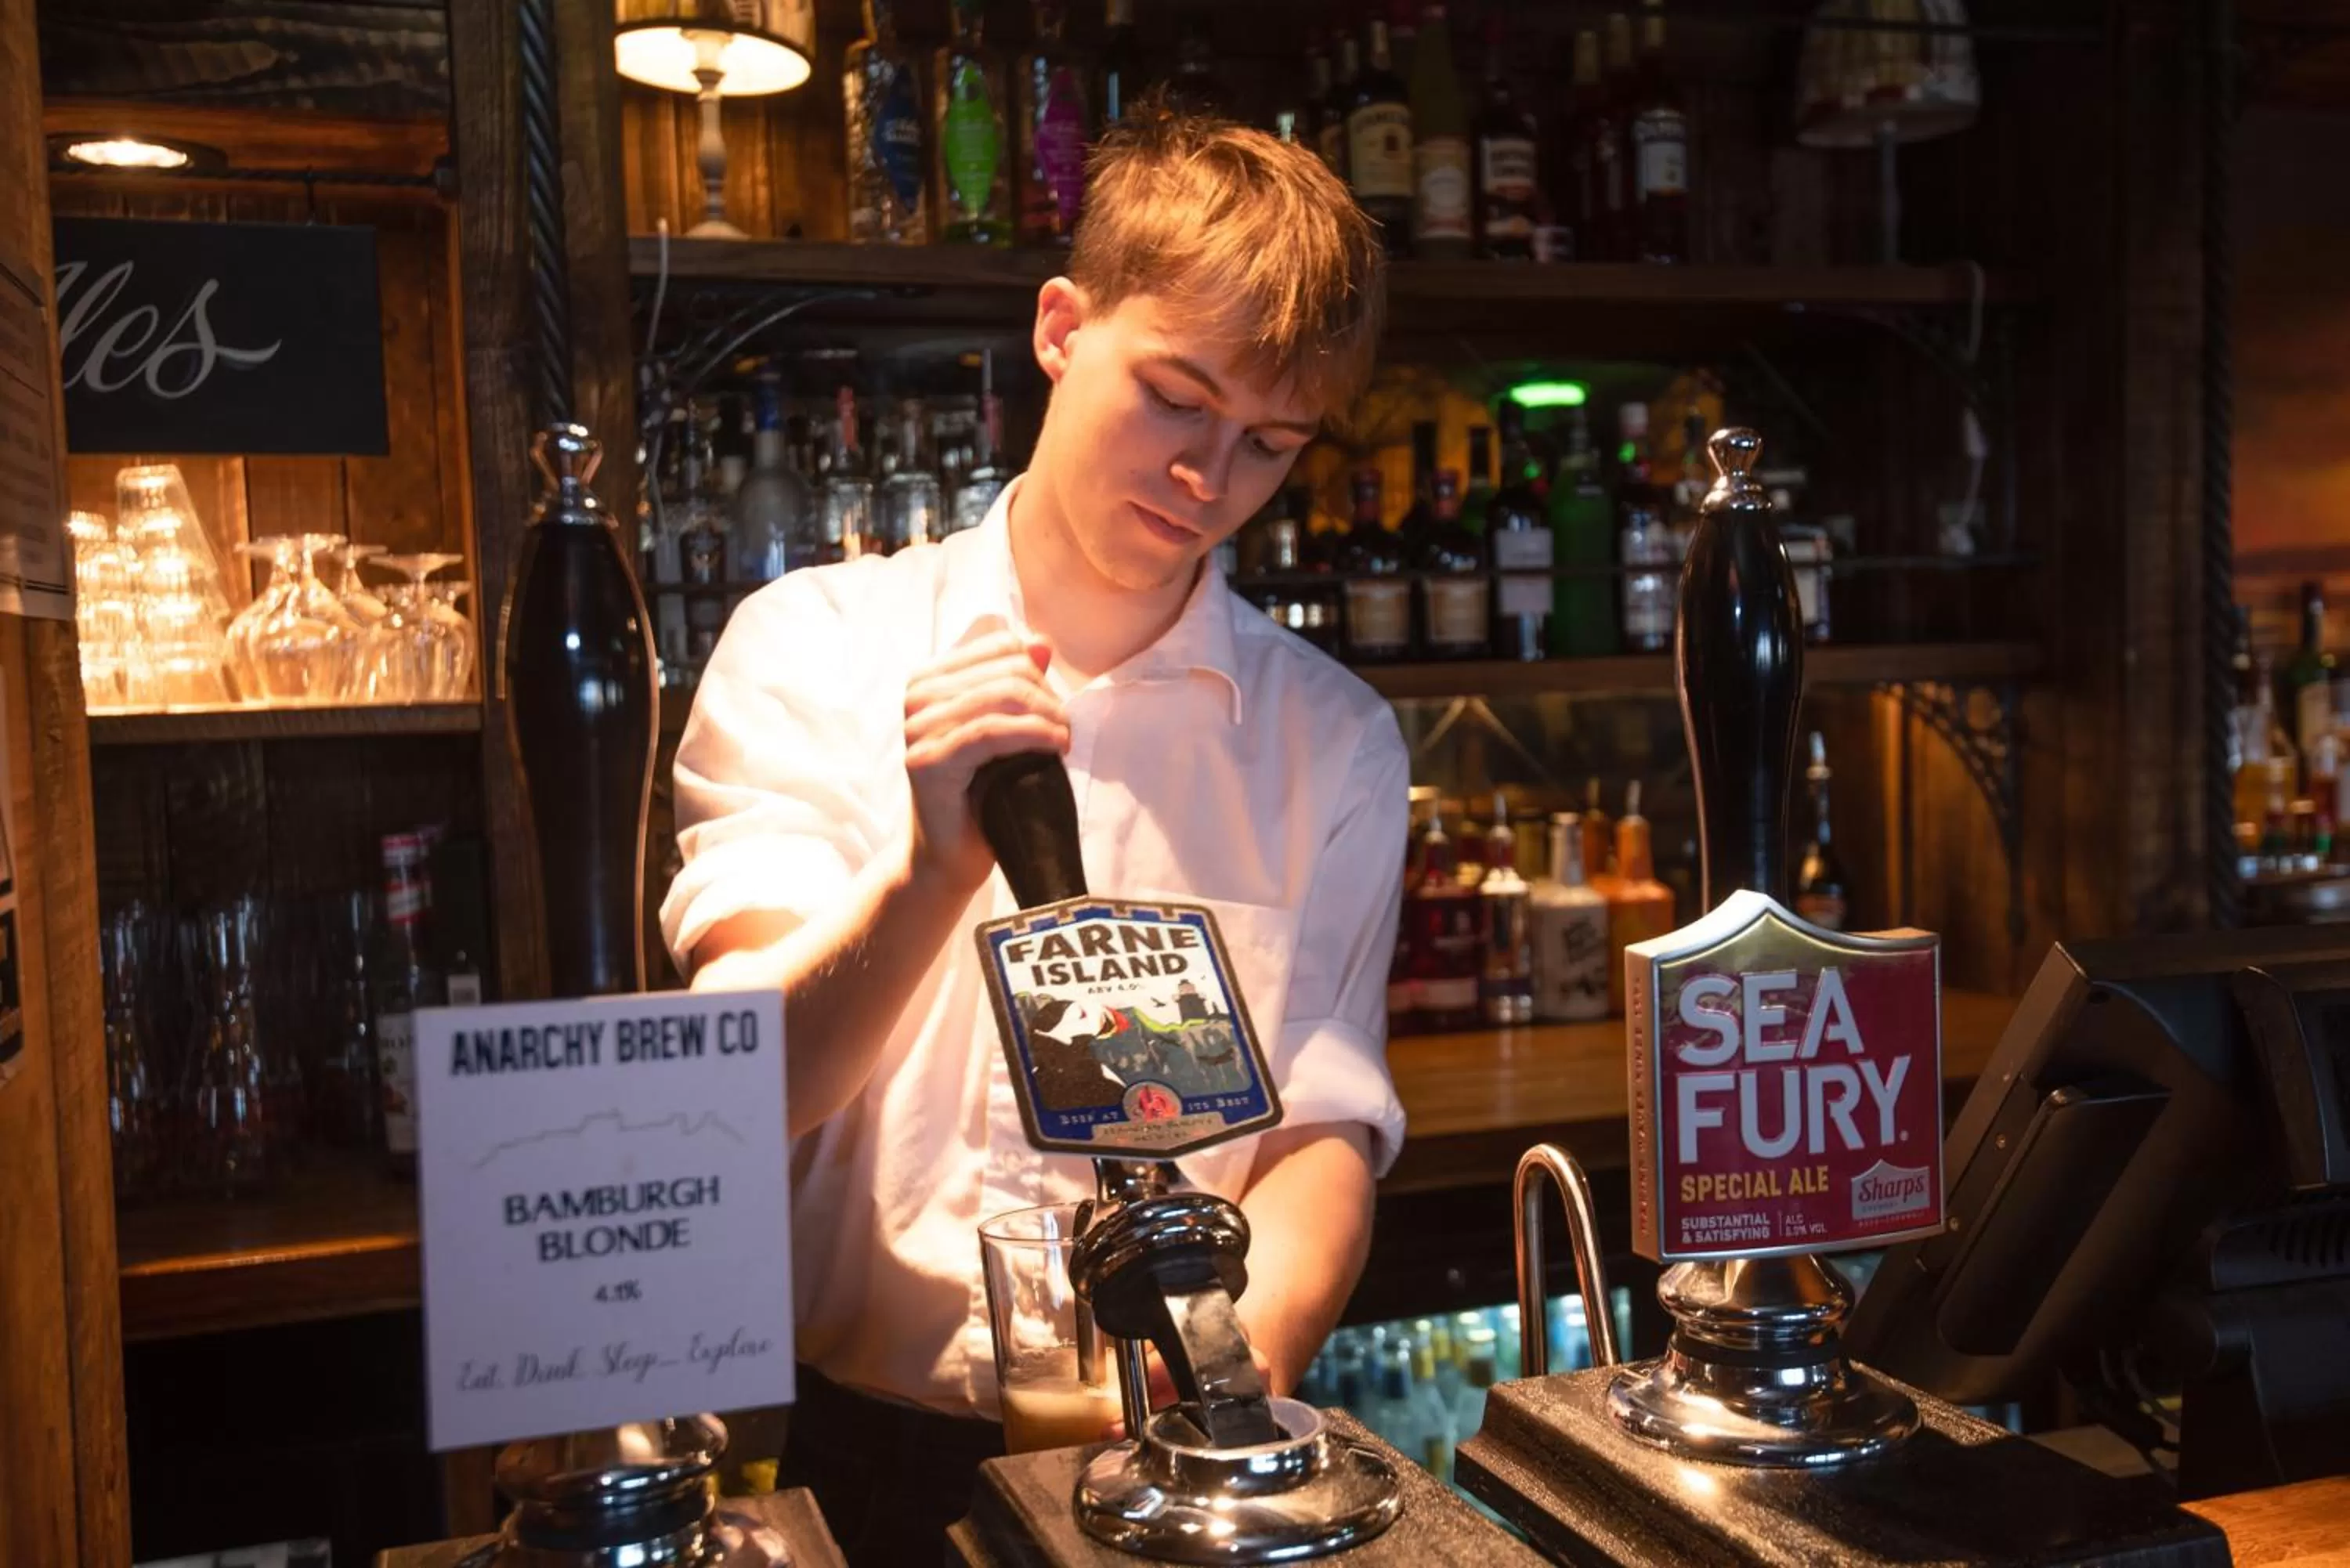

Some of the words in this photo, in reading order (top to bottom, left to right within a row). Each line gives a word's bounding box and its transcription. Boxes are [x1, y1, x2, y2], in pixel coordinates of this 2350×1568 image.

[1006, 923, 1200, 964] FARNE
[1031, 953, 1188, 987] ISLAND
[1677, 966, 1865, 1067] SEA
[450, 1021, 606, 1076] ANARCHY
[617, 1013, 707, 1063] BREW
[718, 1010, 759, 1055] CO
[503, 1175, 720, 1226] BAMBURGH
[1681, 1169, 1782, 1203] SPECIAL
[1788, 1165, 1830, 1196] ALE
[537, 1218, 691, 1263] BLONDE
[1681, 1212, 1770, 1230] SUBSTANTIAL
[1682, 1231, 1693, 1244] &
[1695, 1227, 1770, 1244] SATISFYING
[593, 1279, 642, 1303] 4.1%
